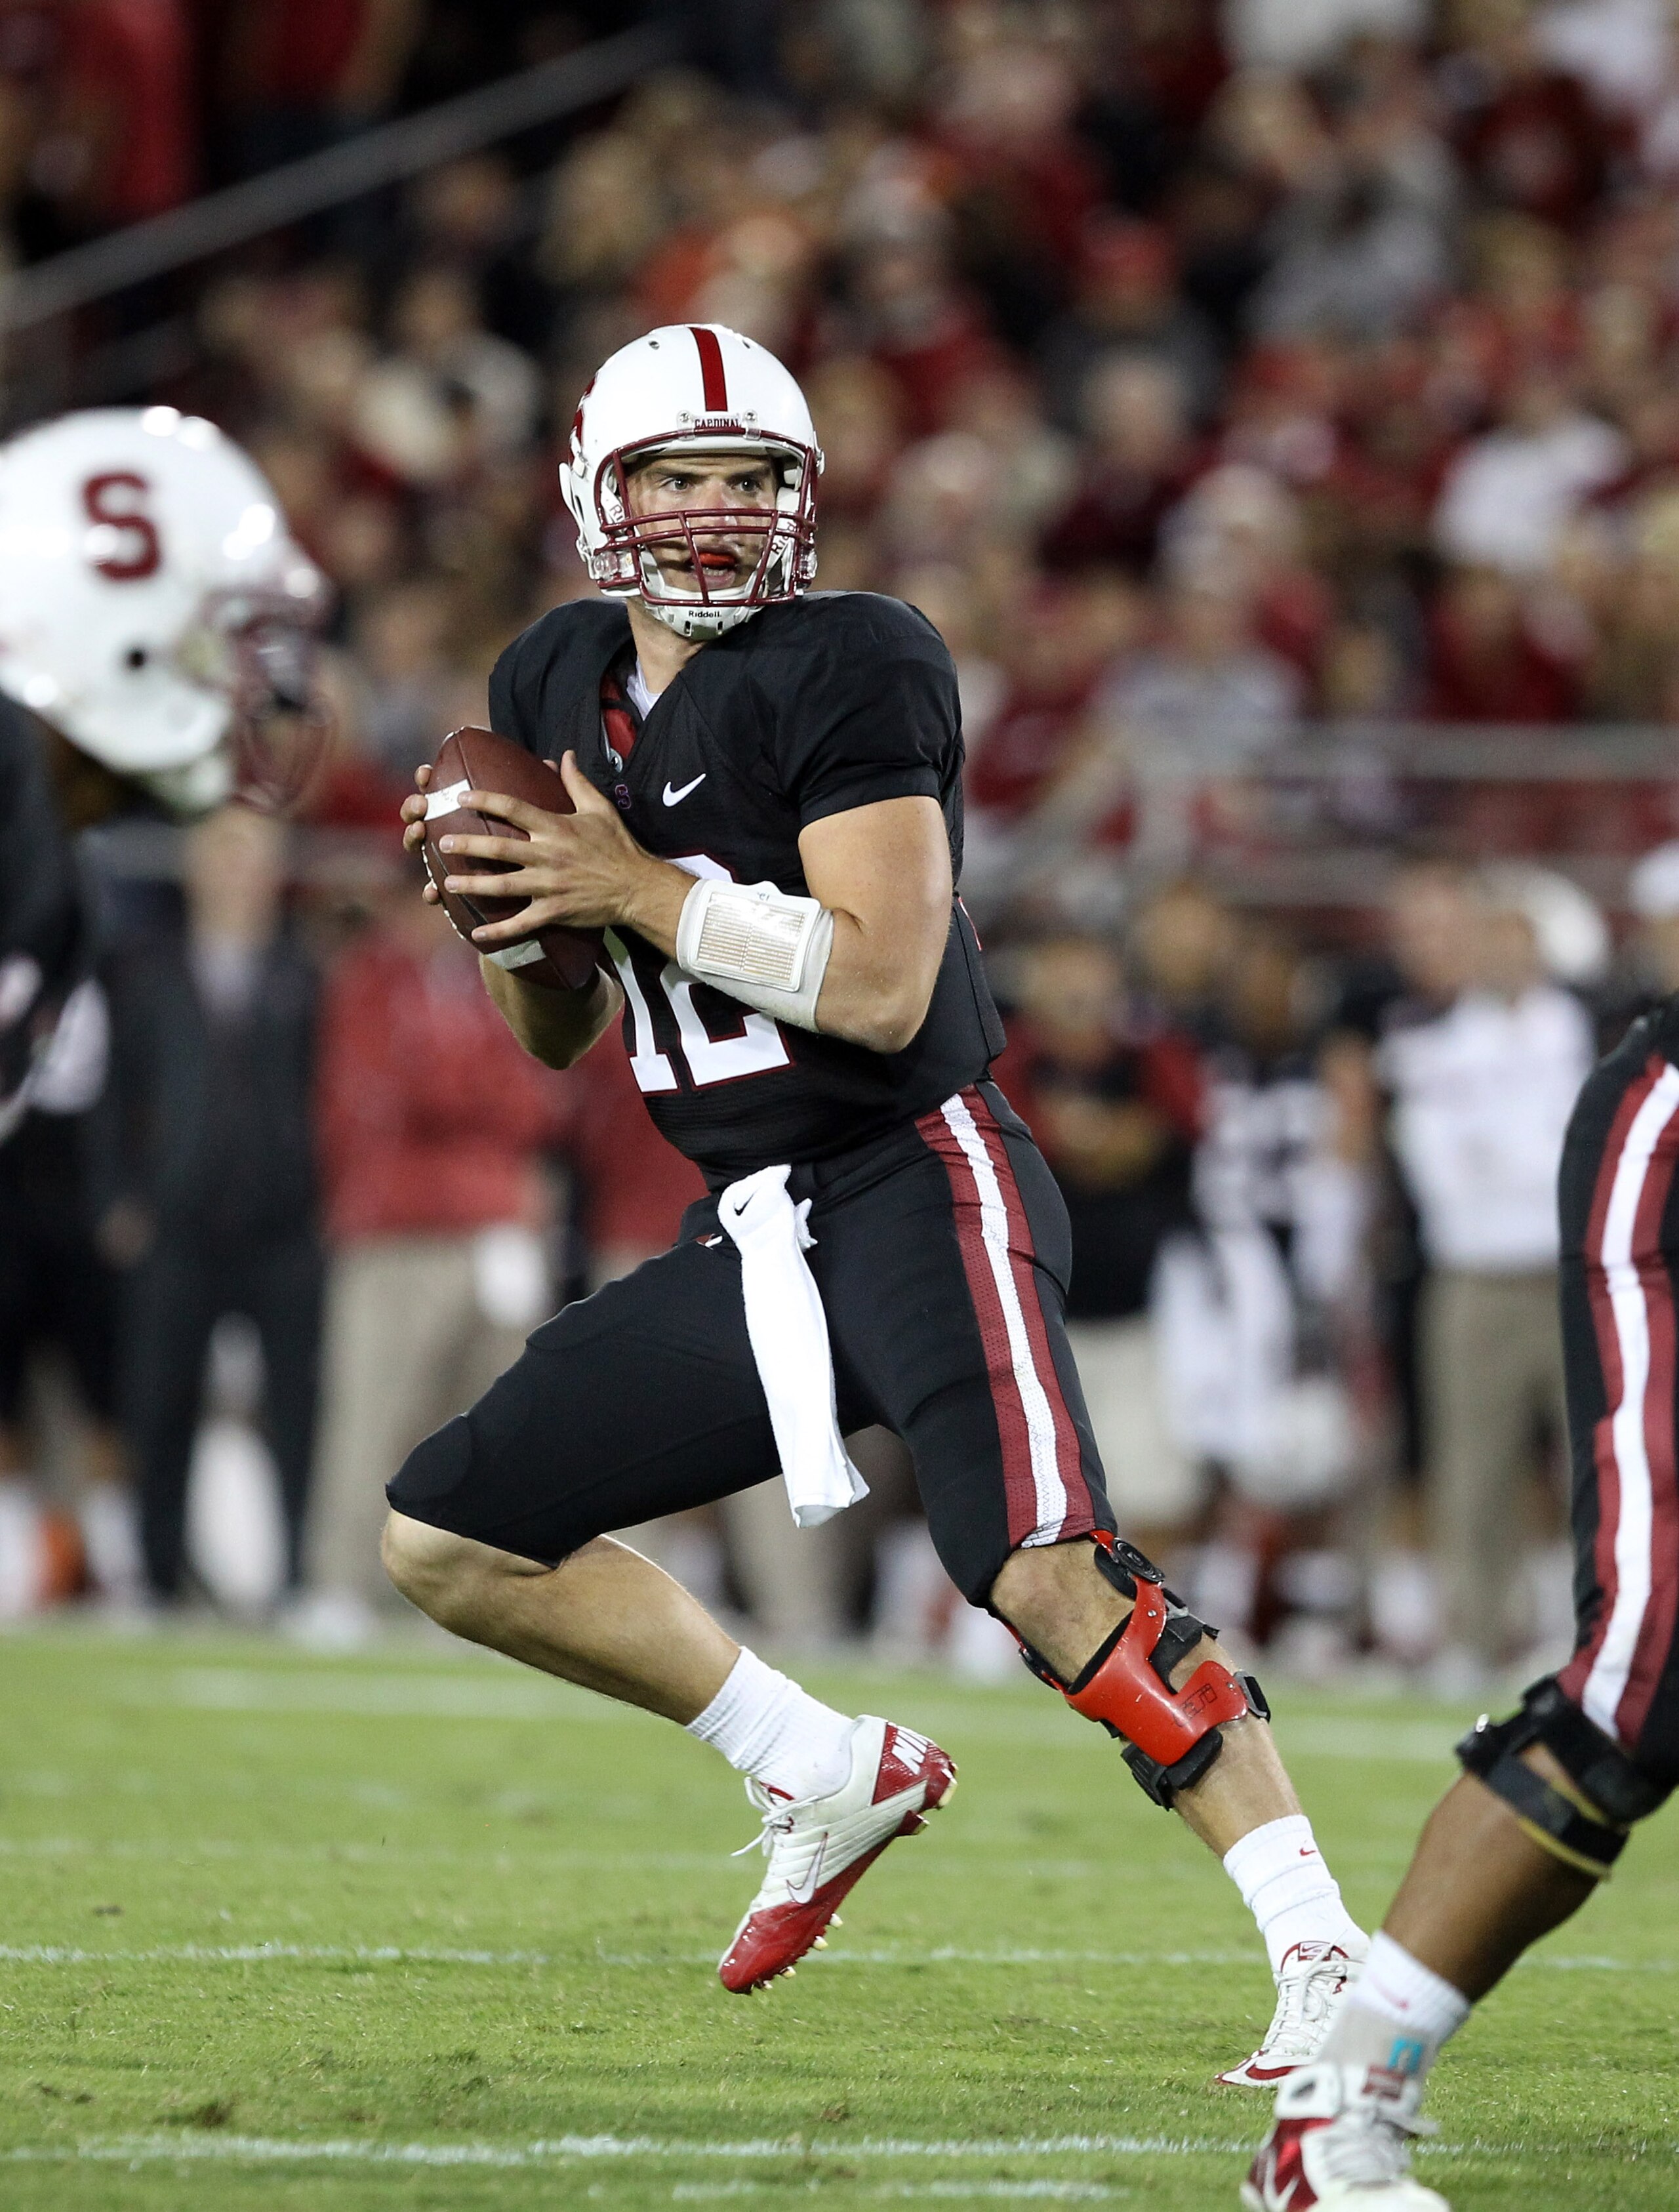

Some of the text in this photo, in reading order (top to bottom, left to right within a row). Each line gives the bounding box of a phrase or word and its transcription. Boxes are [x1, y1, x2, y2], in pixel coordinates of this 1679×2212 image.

[695, 418, 742, 428] CARDINAL
[81, 470, 161, 581] S
[615, 784, 632, 809] S
